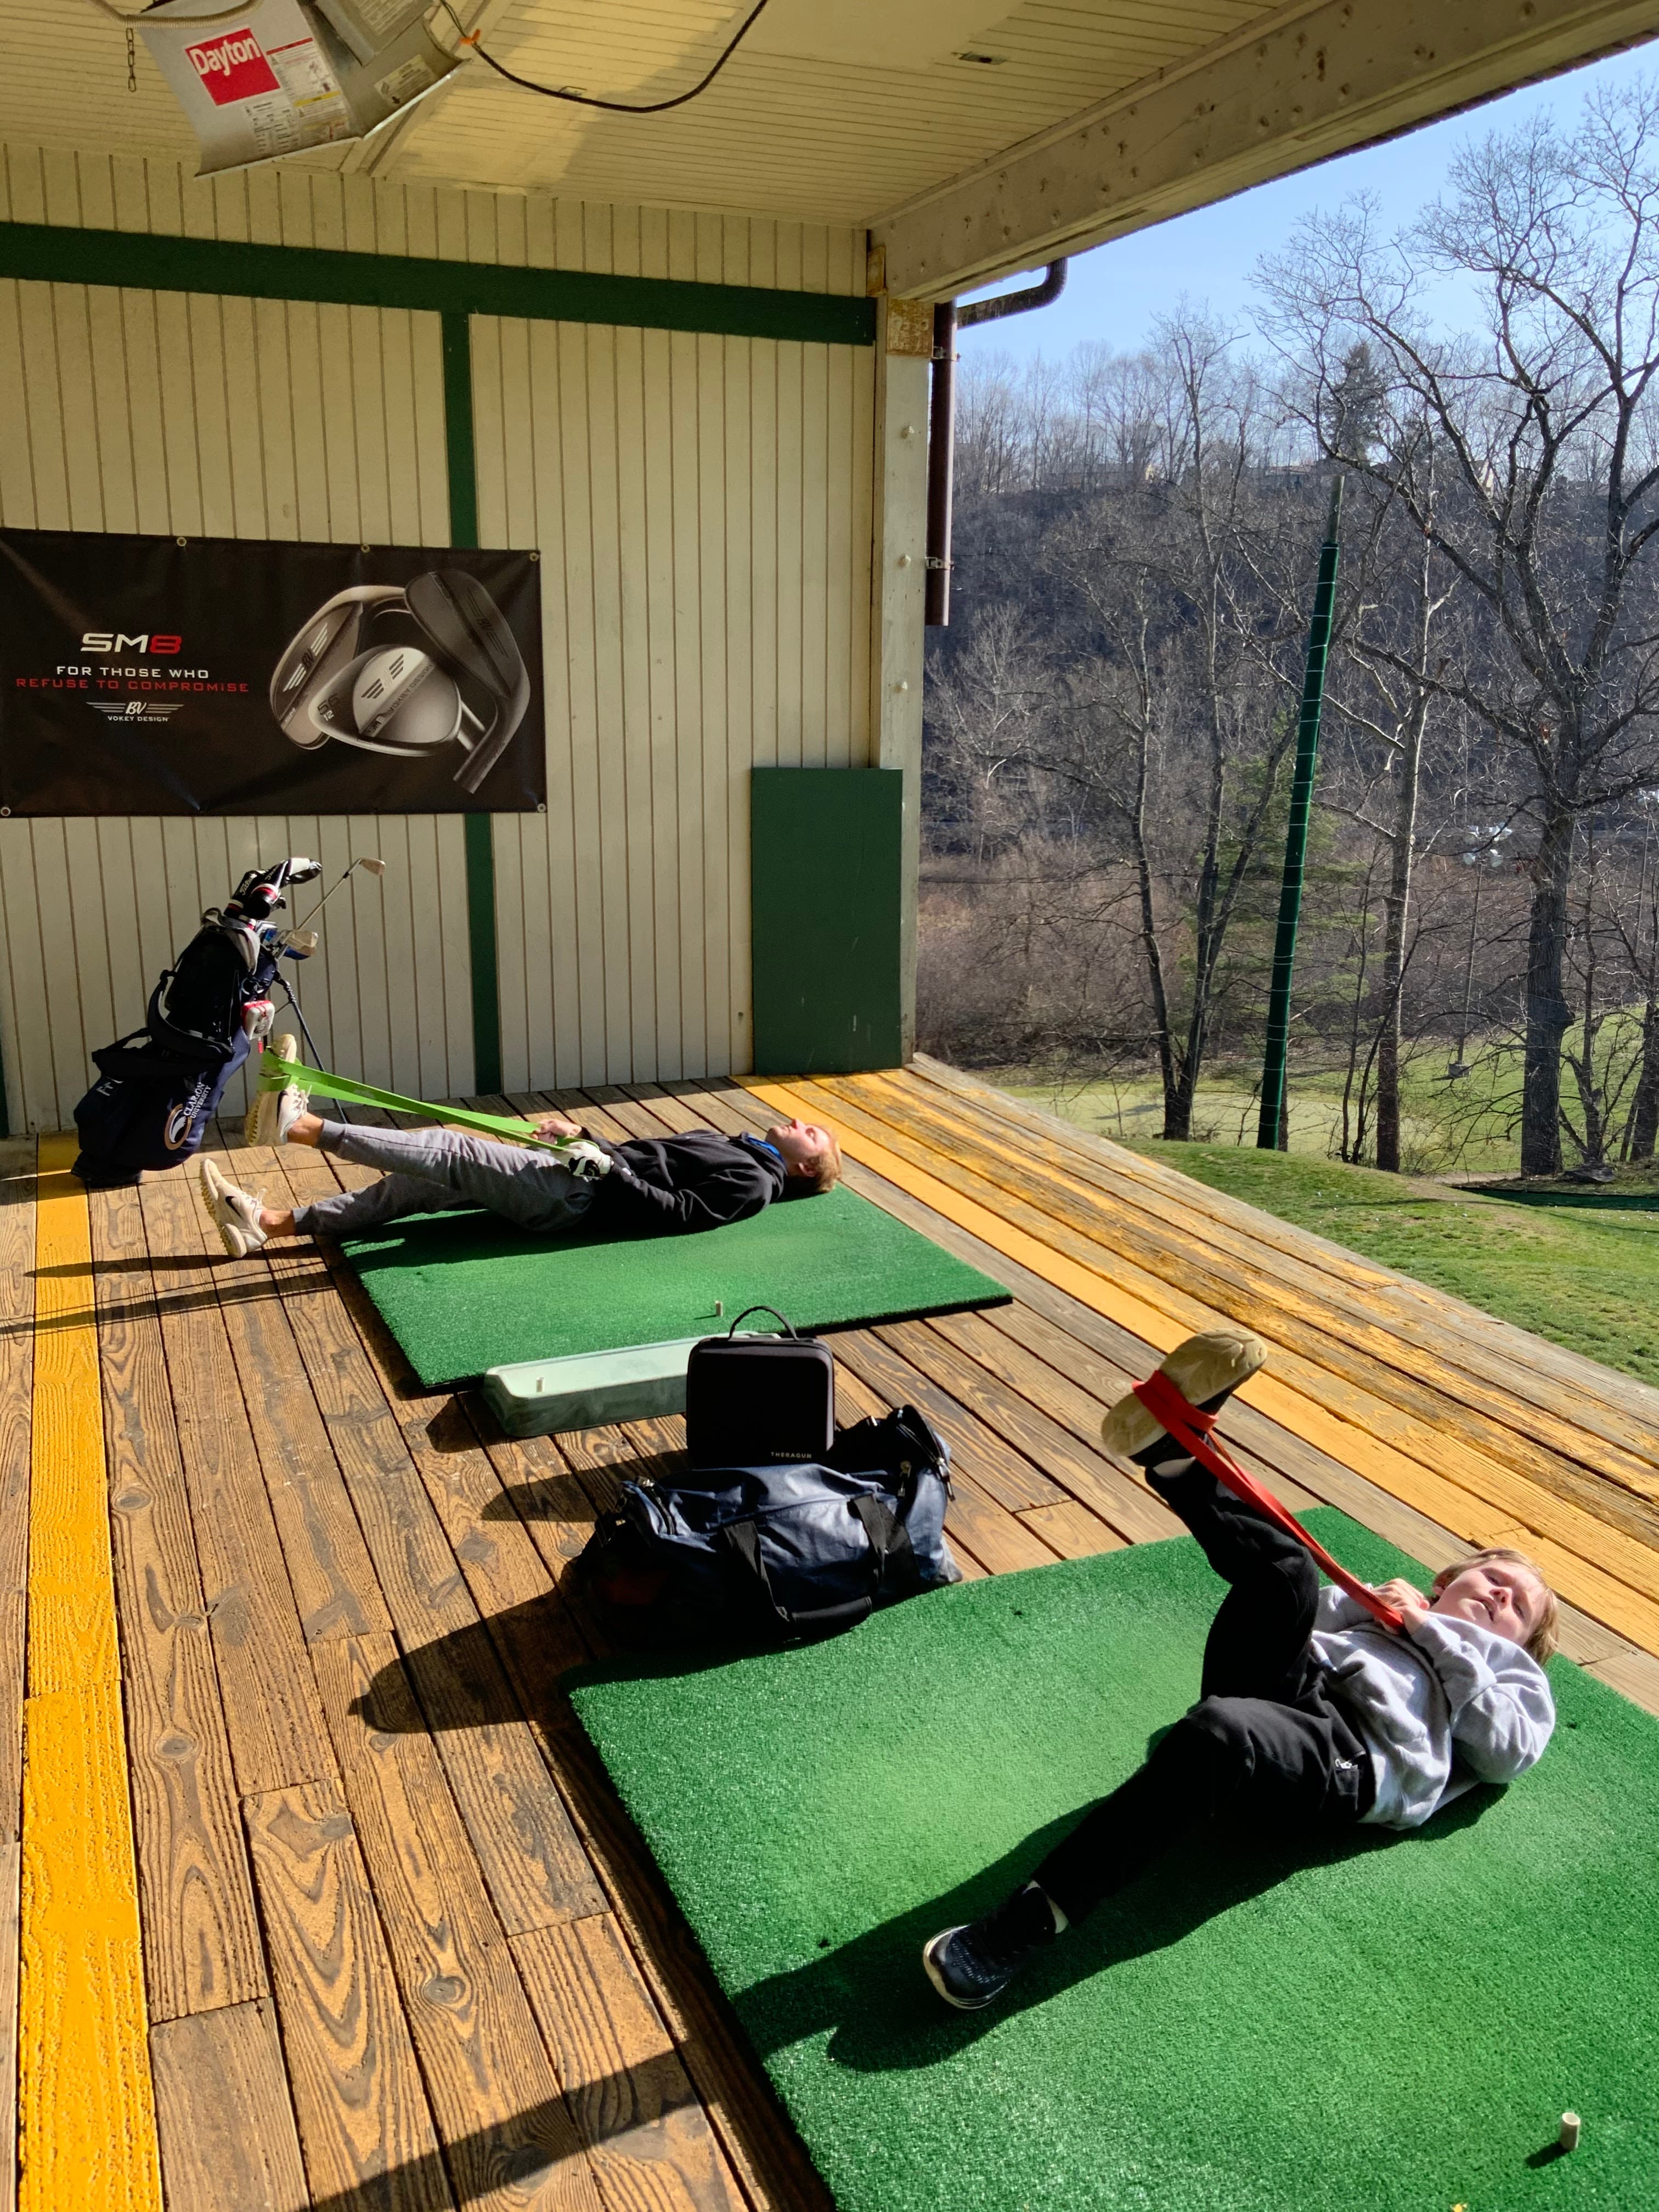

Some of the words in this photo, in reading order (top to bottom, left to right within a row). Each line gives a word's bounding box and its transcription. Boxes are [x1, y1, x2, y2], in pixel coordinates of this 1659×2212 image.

[189, 38, 261, 76] Dayton
[81, 633, 182, 654] SM8
[57, 665, 92, 676] FOR
[99, 667, 161, 678] THOSE
[168, 669, 209, 679] WHO
[16, 678, 88, 689] REFUSE
[96, 680, 119, 689] TO
[128, 681, 249, 692] COMPROMISE
[125, 701, 147, 715] BV
[324, 710, 335, 721] 12
[190, 1085, 211, 1119] UNIVERSITY
